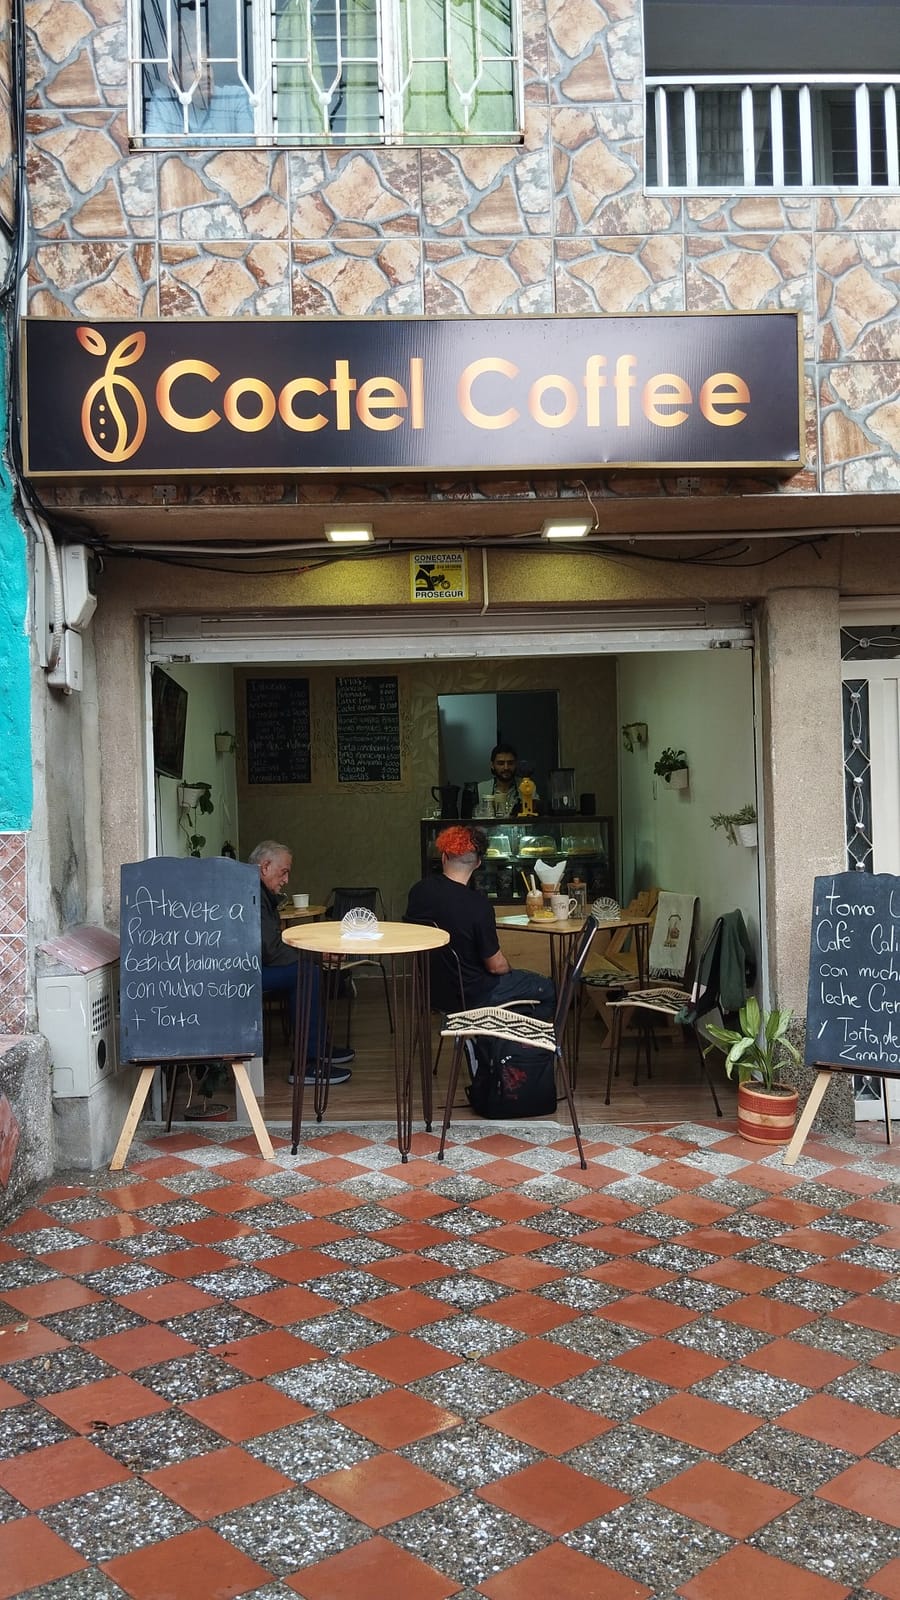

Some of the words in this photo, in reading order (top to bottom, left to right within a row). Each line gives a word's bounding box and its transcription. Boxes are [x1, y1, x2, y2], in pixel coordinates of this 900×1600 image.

[155, 357, 424, 433] Coctel
[457, 354, 751, 431] Coffee
[415, 590, 464, 598] PROSEGUR
[130, 886, 224, 922] Atrevete
[229, 903, 244, 922] a
[128, 917, 181, 947] Probar
[184, 929, 222, 947] una
[816, 918, 855, 953] Café
[185, 951, 262, 975] balanceada
[858, 957, 900, 981] much
[208, 979, 256, 999] sabor
[821, 981, 862, 1009] leche
[151, 1005, 200, 1028] Torta
[839, 1042, 900, 1062] Zanaho
